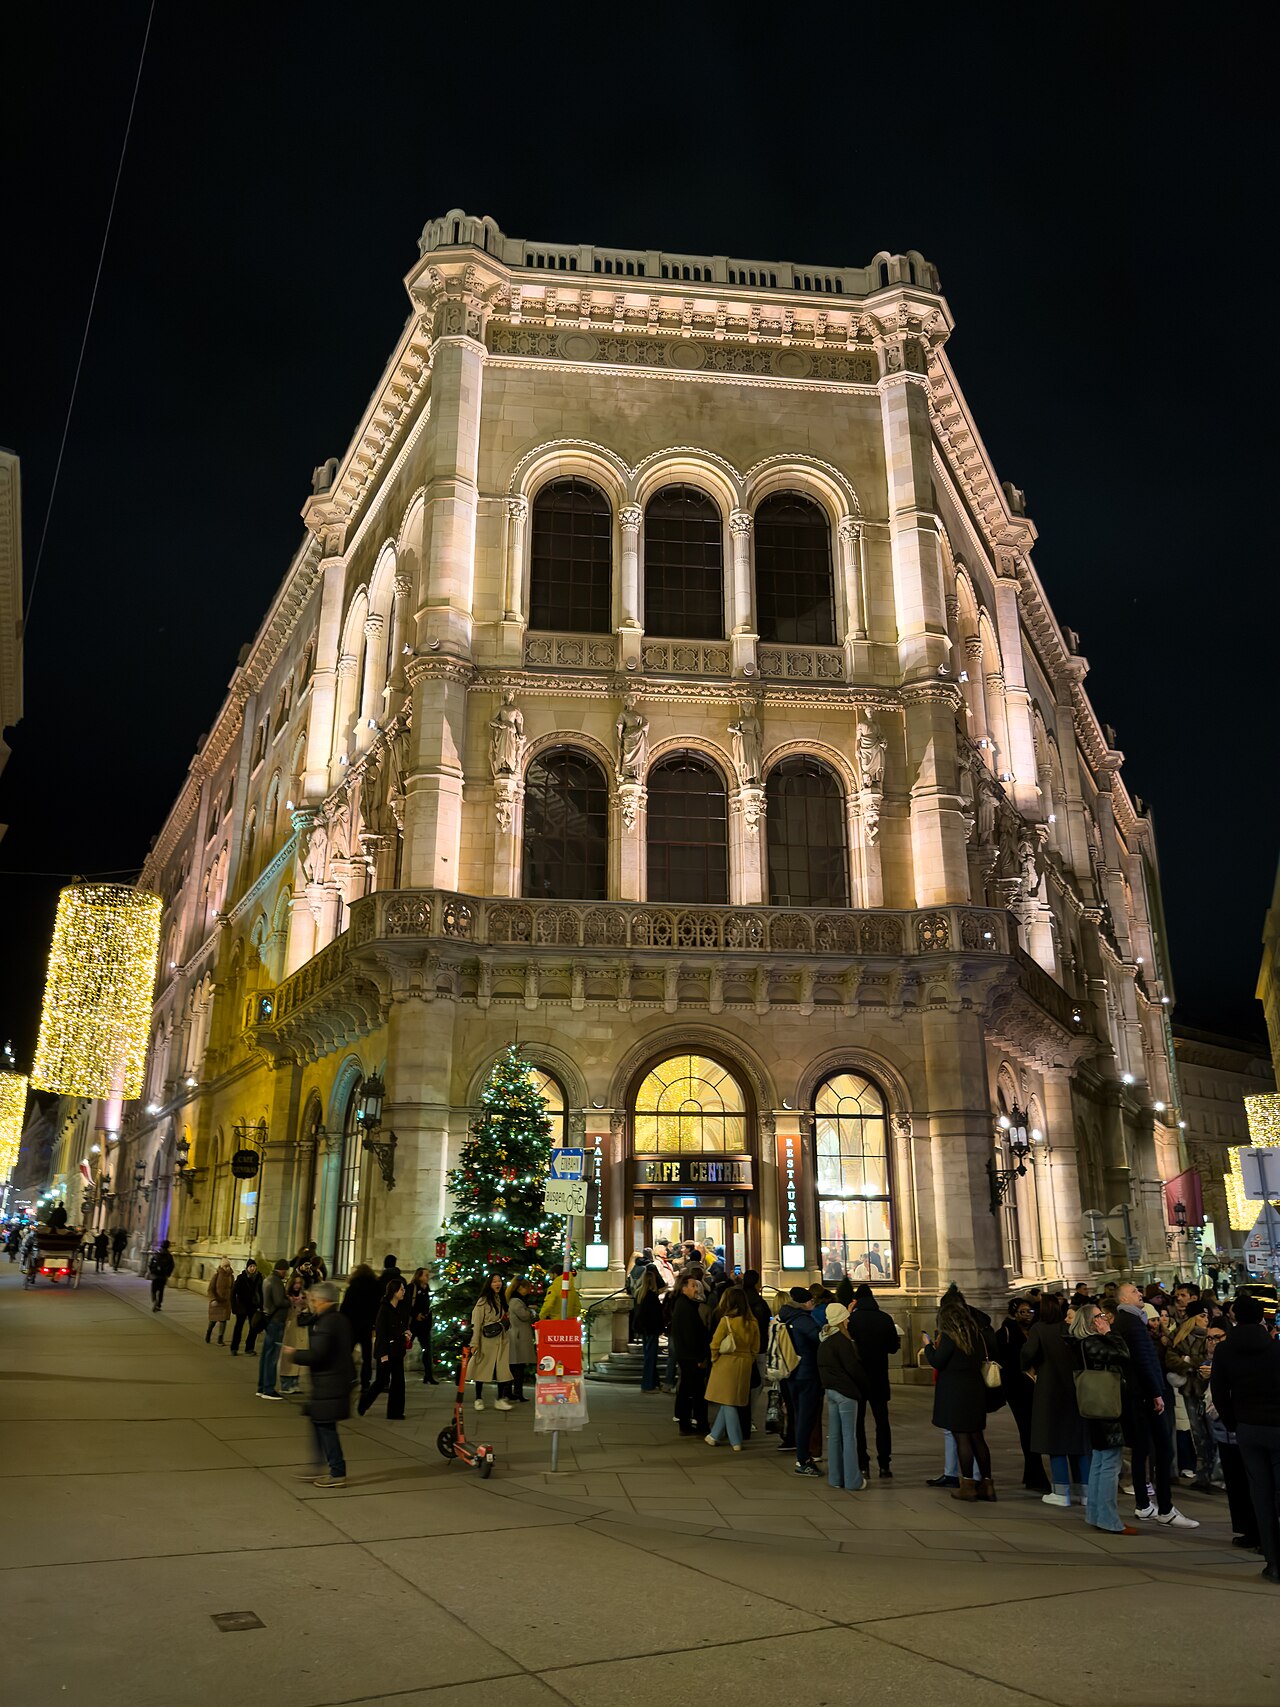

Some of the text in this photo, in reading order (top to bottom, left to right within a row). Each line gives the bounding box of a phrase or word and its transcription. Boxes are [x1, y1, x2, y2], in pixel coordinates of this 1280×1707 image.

[646, 1162, 745, 1182] CAFE CENTRAL
[785, 1138, 797, 1244] RESTAURANT
